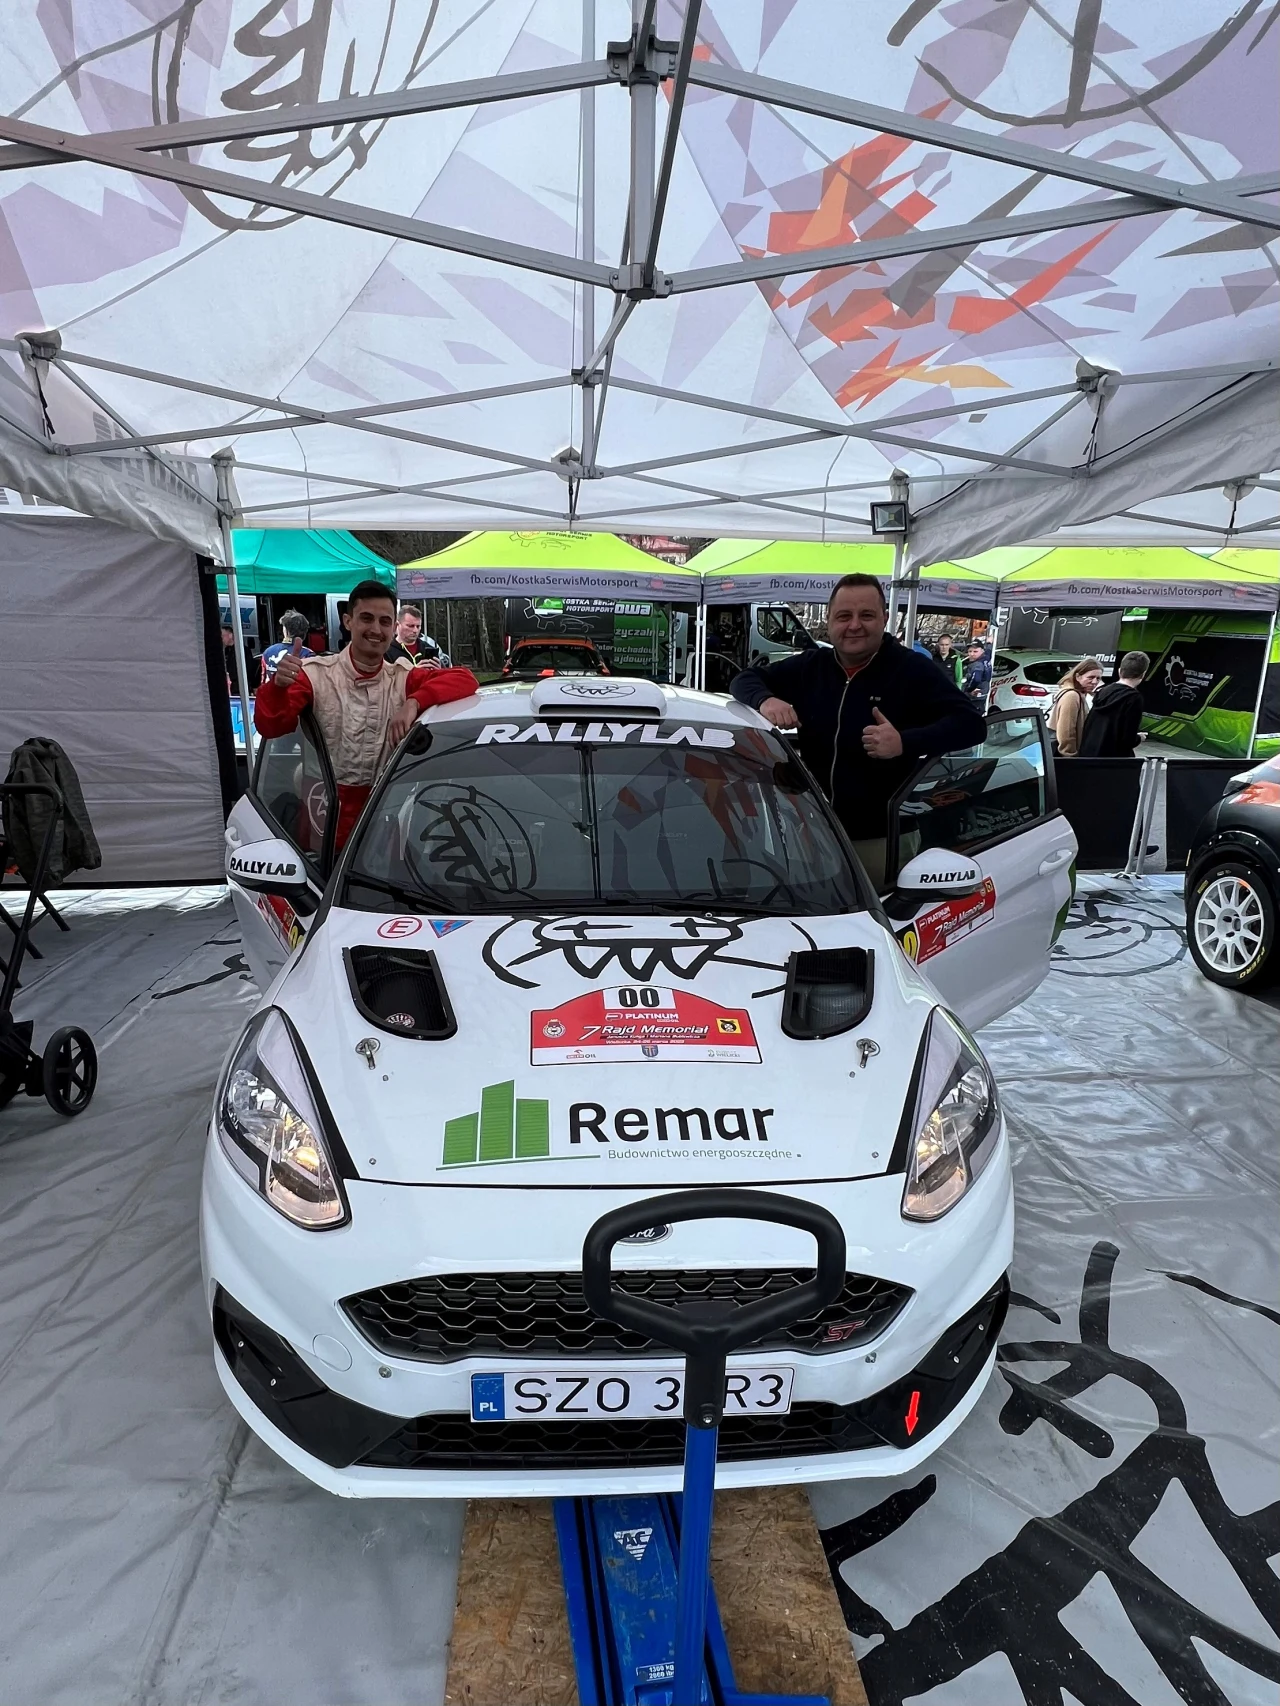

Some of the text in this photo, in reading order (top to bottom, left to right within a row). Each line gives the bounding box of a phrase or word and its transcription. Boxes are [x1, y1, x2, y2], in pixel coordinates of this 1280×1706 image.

[470, 573, 639, 589] fb.com/KostkaSerwisMotorsport
[1067, 583, 1223, 599] fb.com/KostkaSerwisMotorsport
[566, 605, 615, 614] MOTORSPORT
[474, 721, 737, 749] RALLYLAB
[229, 857, 297, 877] RALLYLAB
[919, 869, 976, 884] RALLYLAB
[386, 920, 413, 934] E
[618, 988, 661, 1008] 00
[625, 1012, 679, 1021] PLATINUM
[577, 1025, 602, 1041] 7
[602, 1025, 636, 1036] Rajd
[568, 1101, 775, 1145] Remar
[607, 1148, 793, 1162] Budownictwo energooszczędne
[822, 1320, 865, 1343] ST
[514, 1373, 784, 1413] SZO 3R3
[479, 1402, 498, 1412] PL
